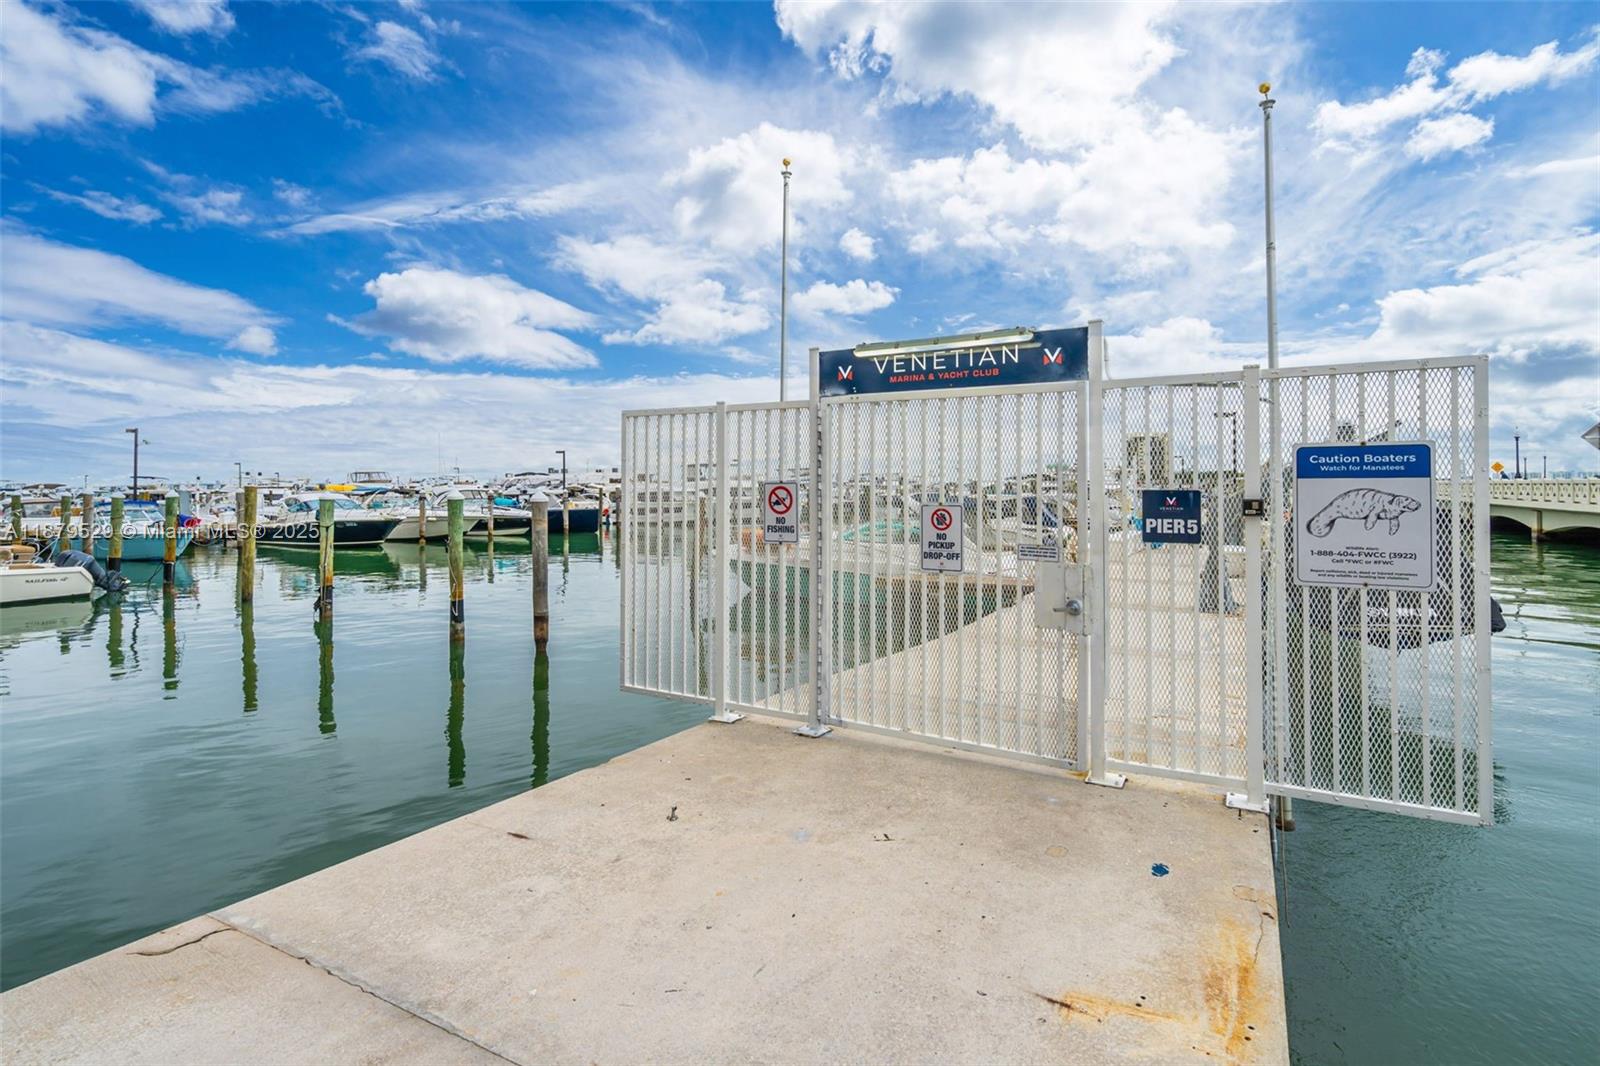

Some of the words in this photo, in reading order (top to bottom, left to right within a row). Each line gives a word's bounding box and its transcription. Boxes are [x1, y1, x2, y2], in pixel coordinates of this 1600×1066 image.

[874, 344, 1020, 374] VENETIAN
[889, 374, 925, 384] MARINA
[928, 372, 935, 381] &
[938, 370, 968, 380] YACHT
[972, 368, 1000, 378] CLUB
[1309, 454, 1360, 464] Caution
[1364, 454, 1417, 463] Boaters
[775, 516, 786, 524] NO
[766, 524, 795, 534] FISHING
[1146, 518, 1186, 534] PIER
[936, 532, 947, 540] NO
[928, 541, 956, 550] PICKUP
[923, 552, 960, 560] DROP-OFF
[1310, 550, 1386, 559] 1-888-404-FWCC
[1388, 551, 1417, 560] (3922)
